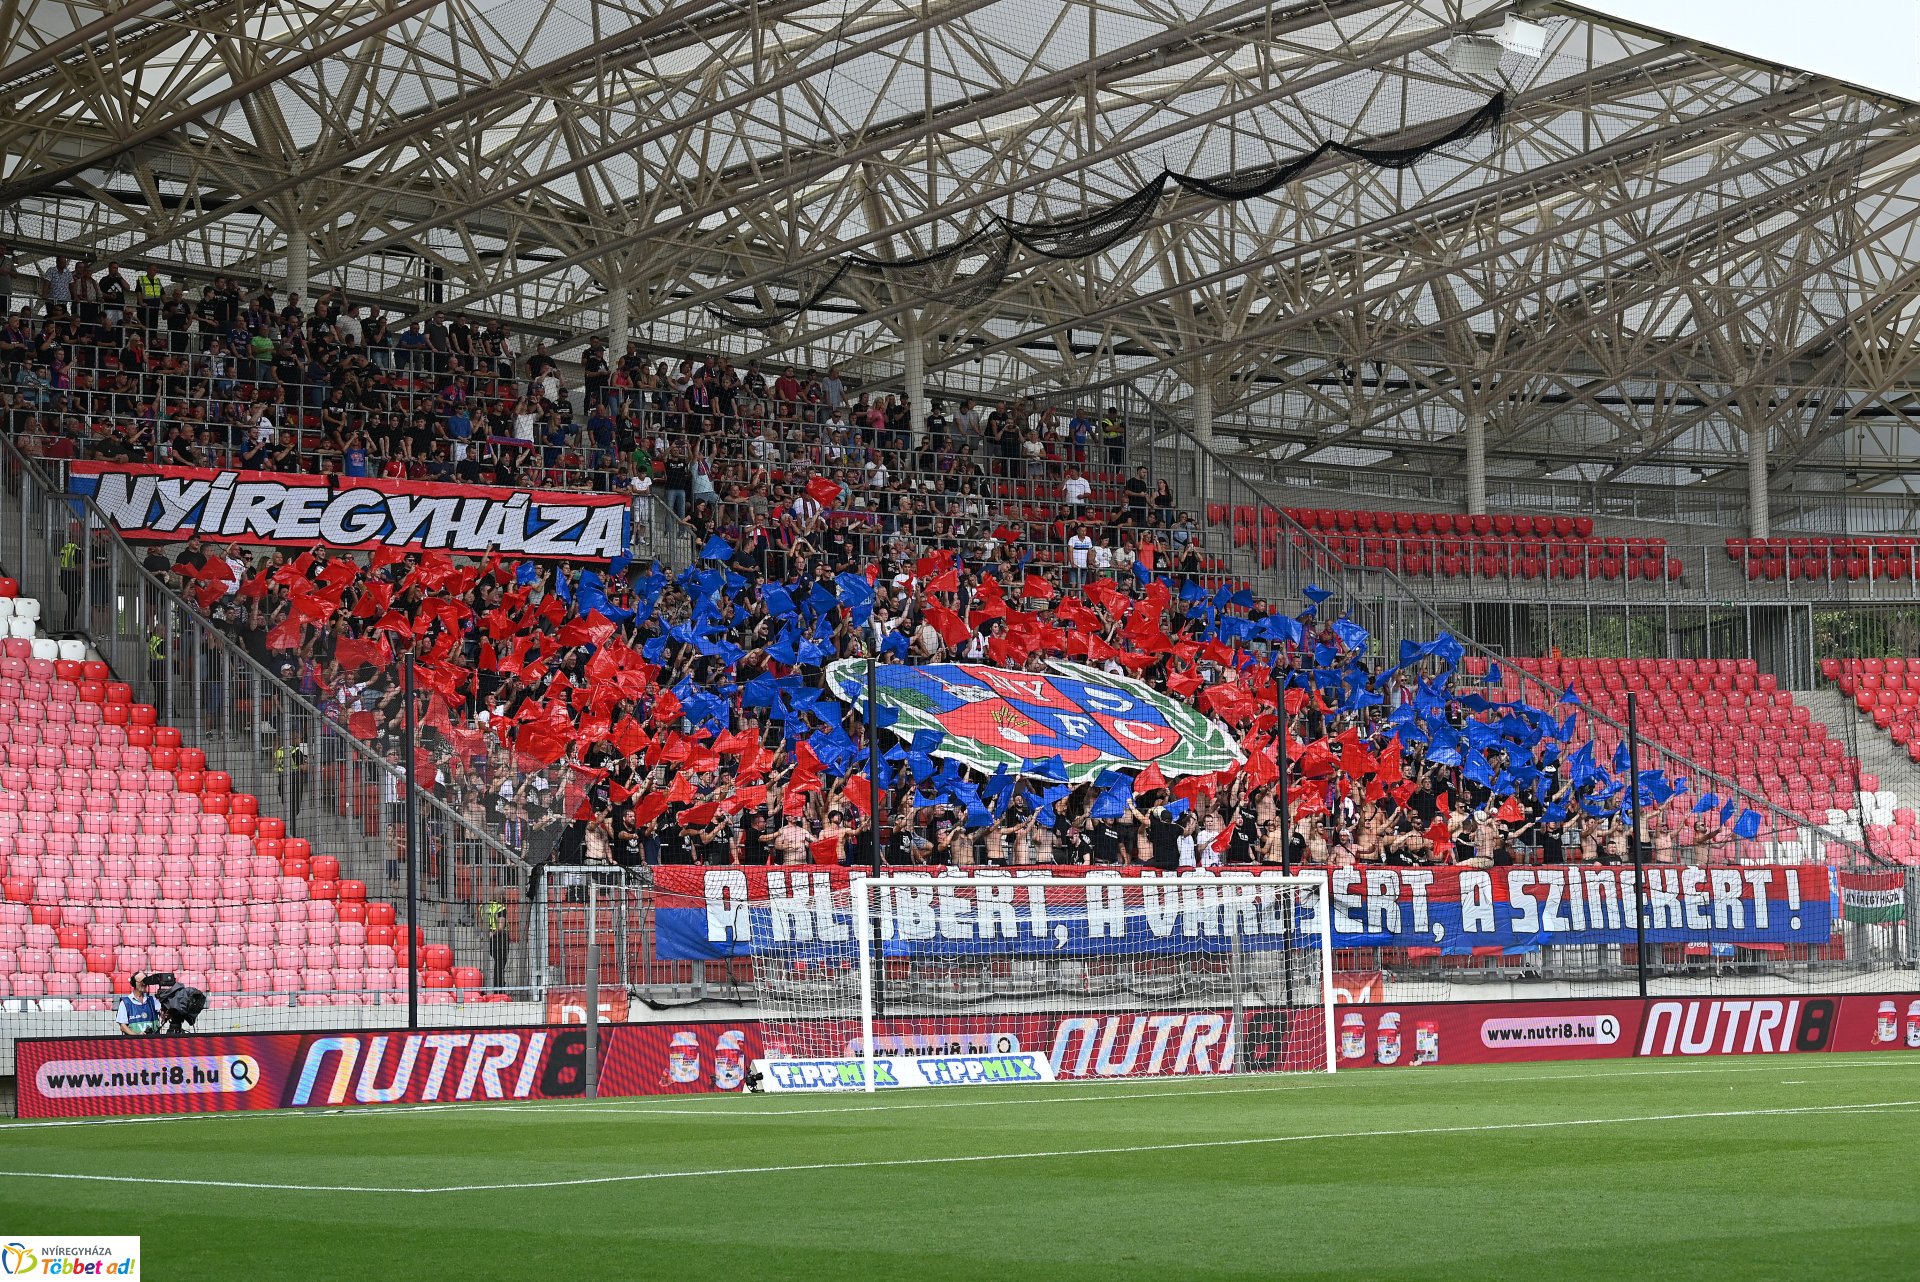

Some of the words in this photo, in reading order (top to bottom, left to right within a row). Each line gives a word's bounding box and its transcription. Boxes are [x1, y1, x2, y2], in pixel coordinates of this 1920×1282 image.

[94, 470, 625, 559] NYÍREGYHÁZA
[1053, 713, 1094, 738] F
[1113, 719, 1164, 745] C
[704, 869, 751, 942] A
[1085, 869, 1126, 938] A
[1458, 869, 1497, 933] A
[1487, 1022, 1596, 1041] www.nutri8.hu
[1639, 998, 1835, 1055] NUTRI8
[46, 1066, 220, 1089] www.nutri8.hu
[291, 1031, 600, 1105] NUTRI8
